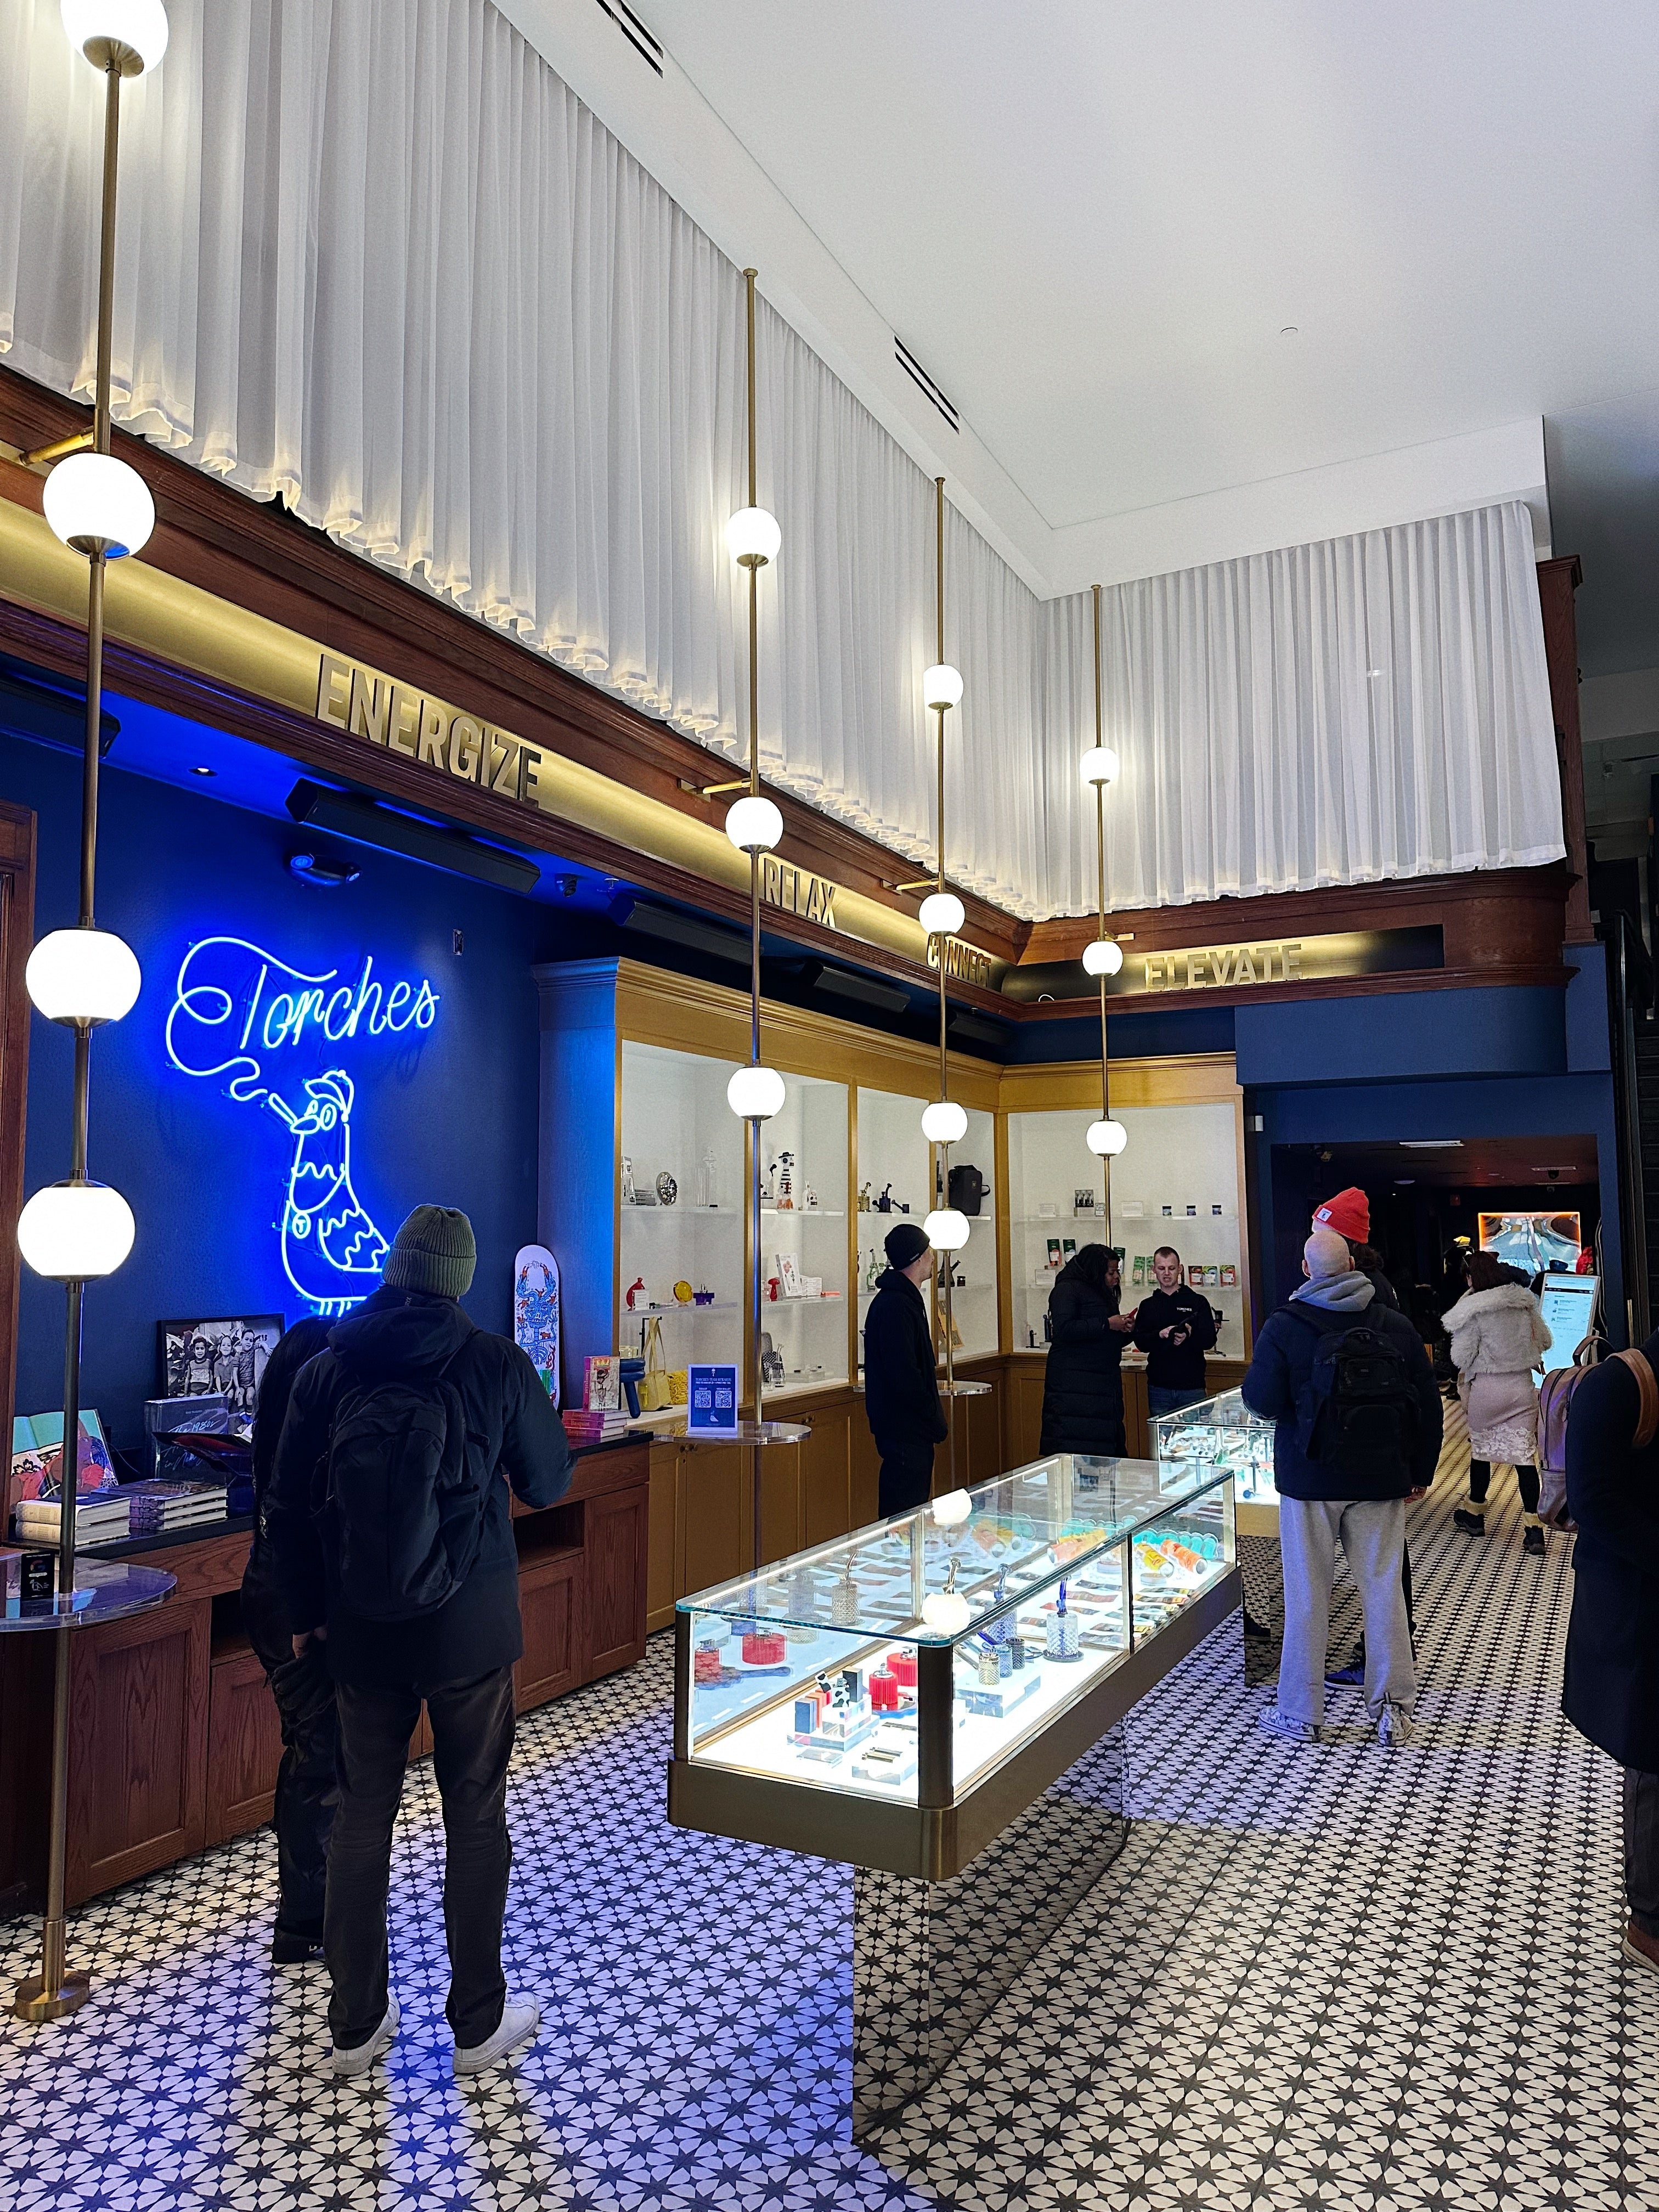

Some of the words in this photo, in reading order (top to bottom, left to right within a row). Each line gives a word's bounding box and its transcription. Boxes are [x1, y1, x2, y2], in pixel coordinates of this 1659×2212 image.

[316, 653, 541, 808] ENERGIZE
[764, 857, 836, 928] RELAX
[166, 936, 440, 1064] Torches
[1145, 944, 1302, 992] ELEVATE
